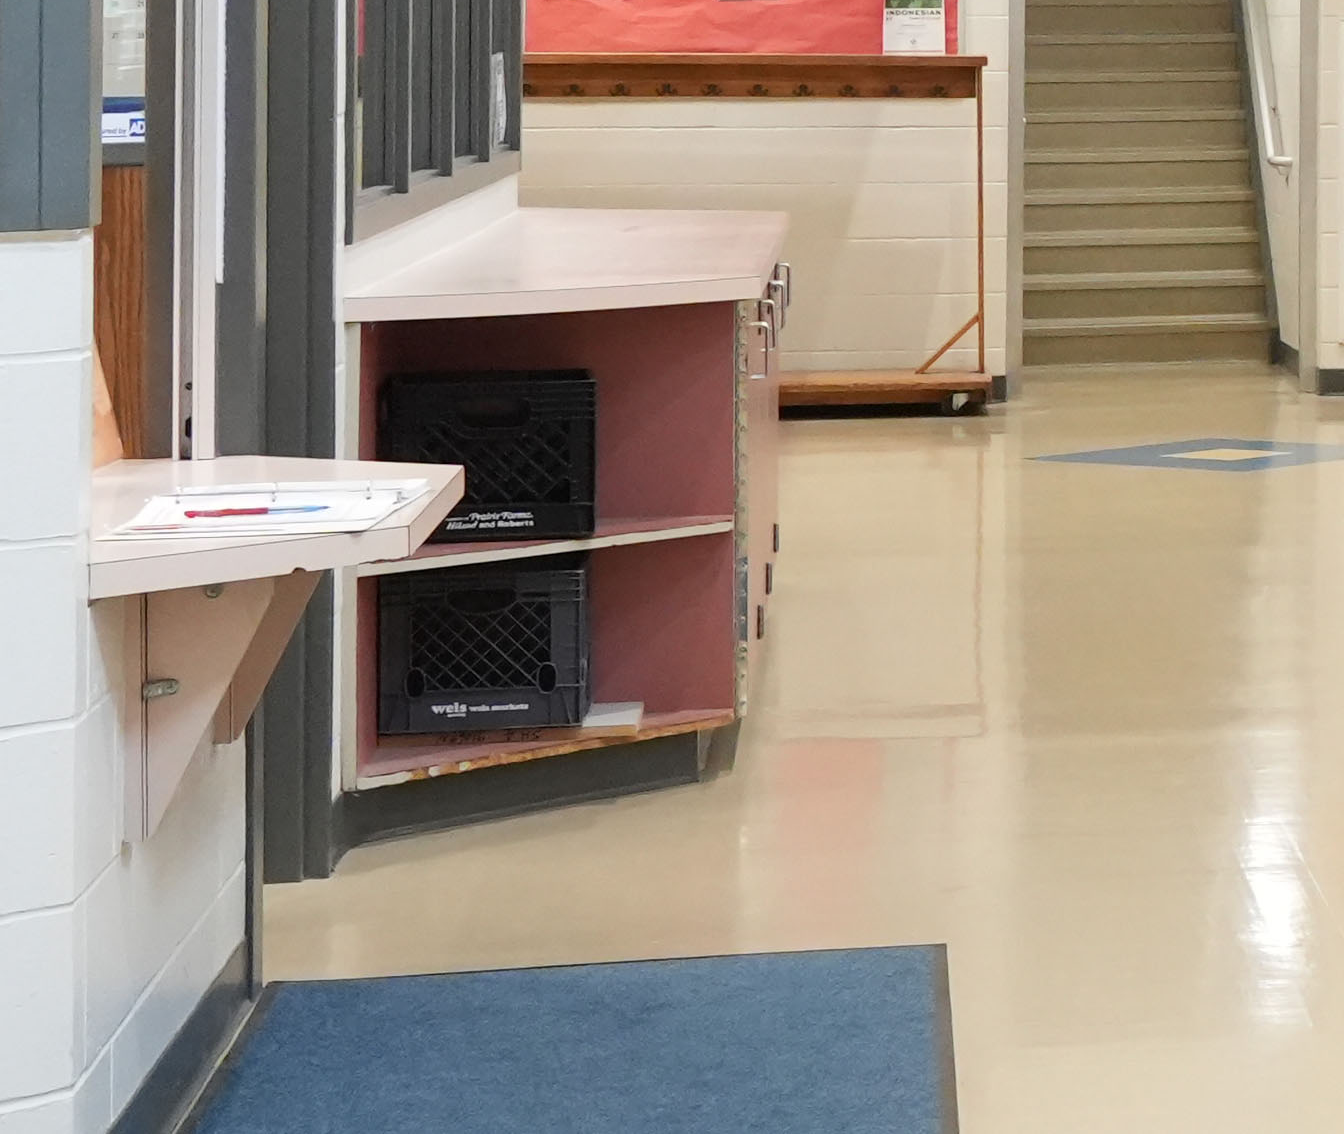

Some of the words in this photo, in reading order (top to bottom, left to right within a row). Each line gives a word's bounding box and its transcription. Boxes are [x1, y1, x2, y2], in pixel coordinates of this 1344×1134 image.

[131, 120, 146, 134] AD
[478, 521, 496, 529] and
[431, 702, 467, 715] weis
